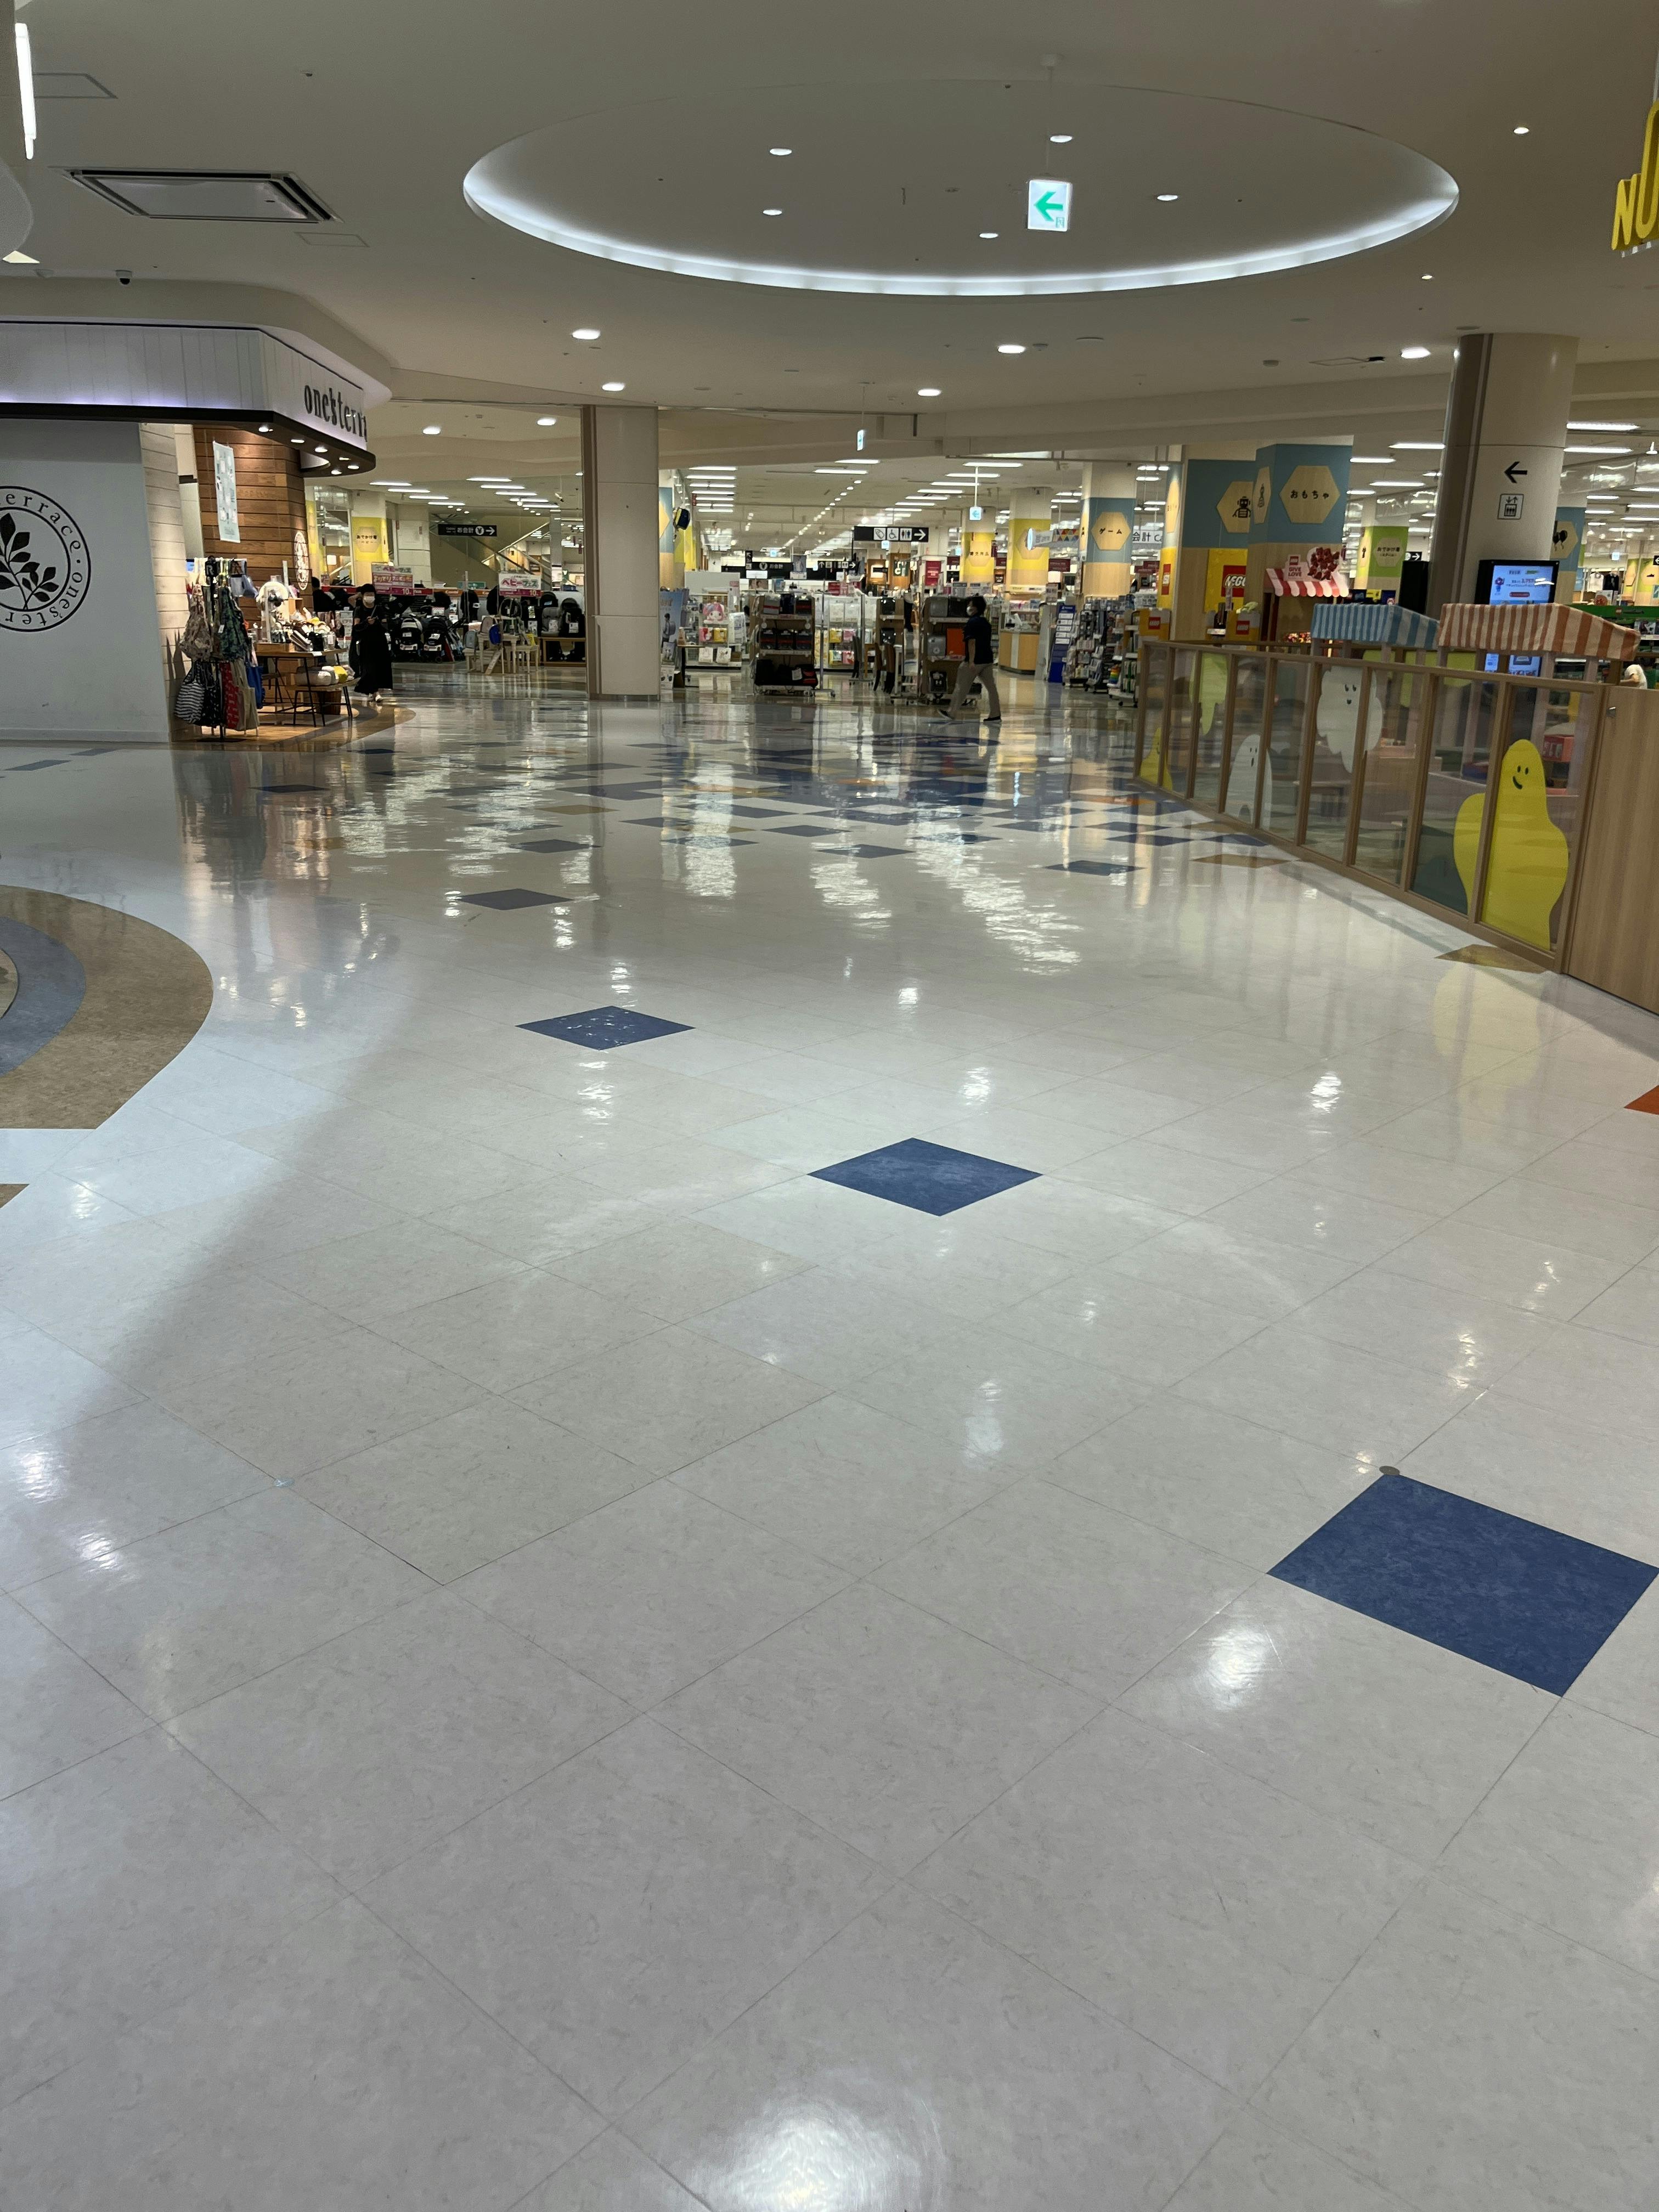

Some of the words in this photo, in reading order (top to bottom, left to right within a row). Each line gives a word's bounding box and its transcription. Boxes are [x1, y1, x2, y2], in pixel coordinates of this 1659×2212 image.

[1290, 490, 1329, 499] おもちゃ
[0, 494, 81, 553] errace
[1132, 532, 1151, 541] 会計
